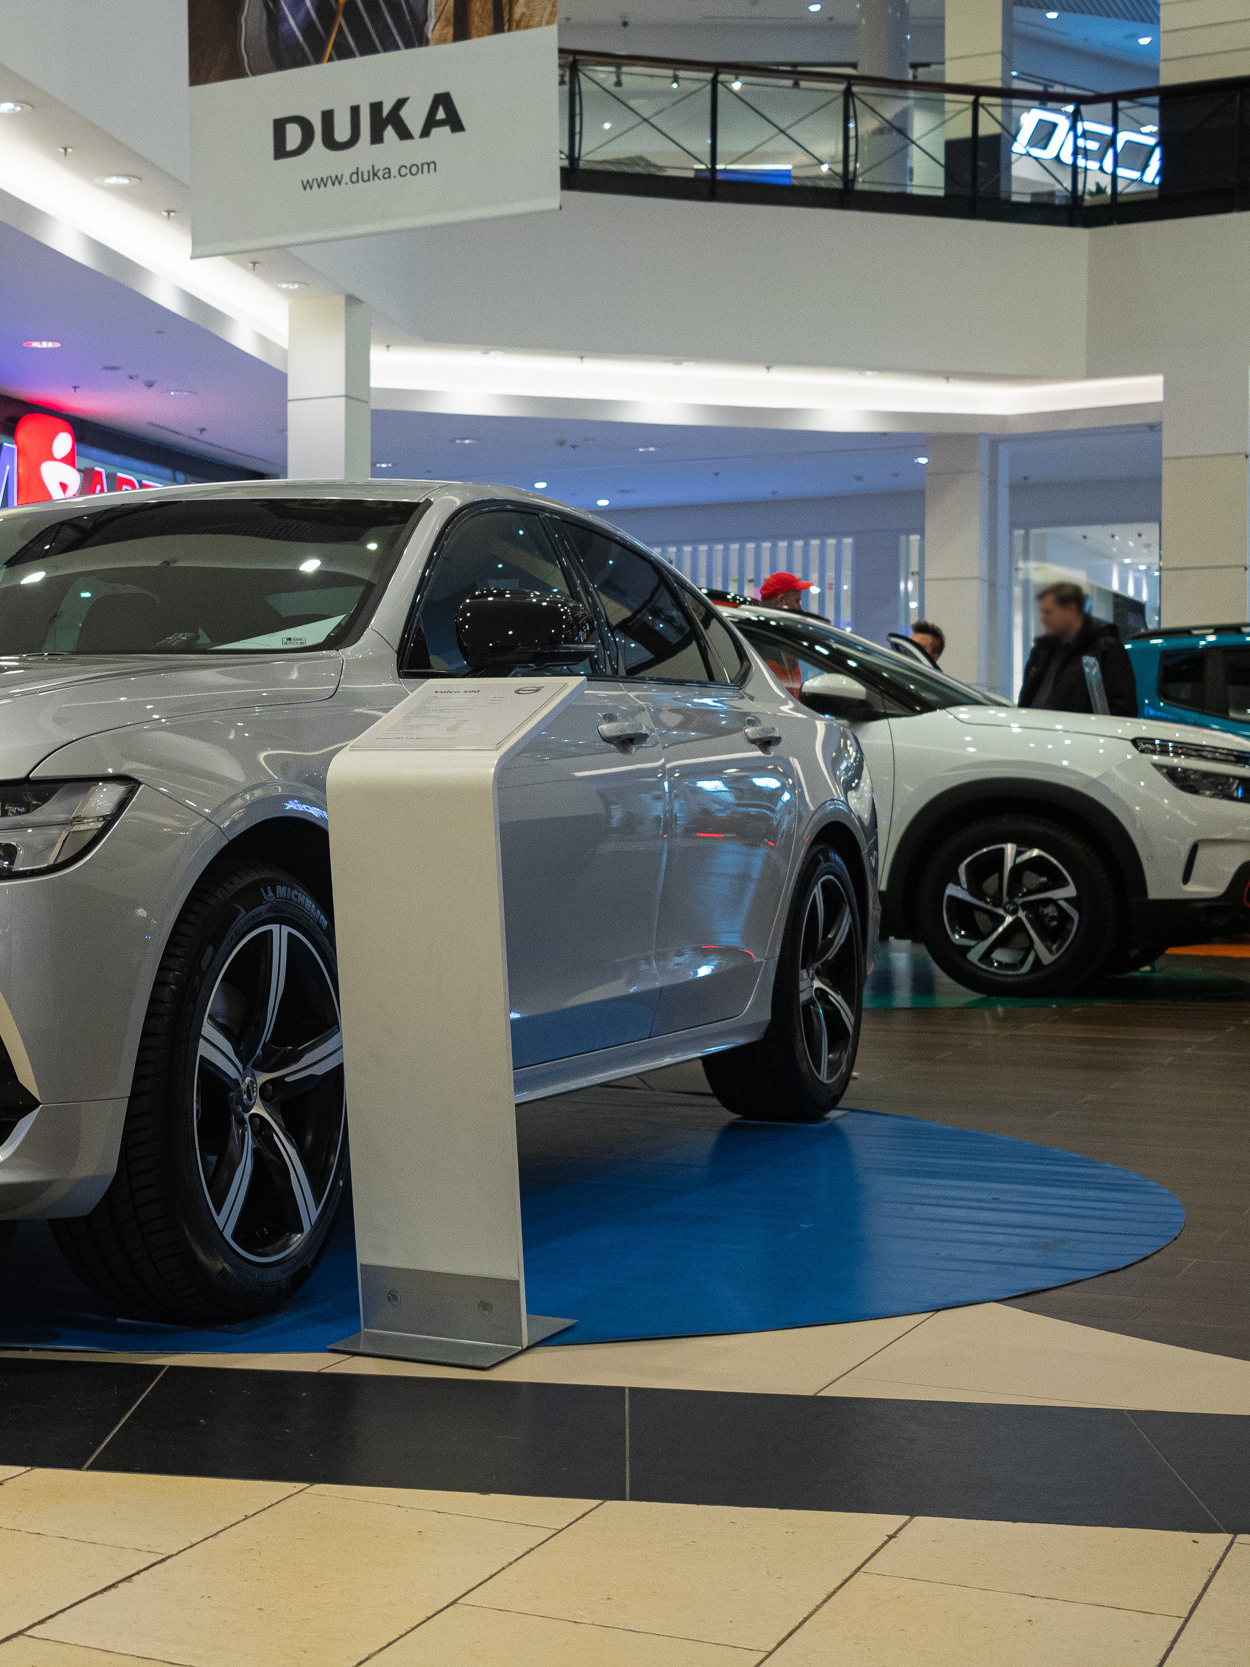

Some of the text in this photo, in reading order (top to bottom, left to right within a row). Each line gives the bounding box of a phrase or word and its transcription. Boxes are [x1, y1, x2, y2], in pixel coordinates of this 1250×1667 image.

[273, 91, 466, 161] DUKA
[301, 159, 437, 192] www.duka.com
[276, 885, 328, 930] MICHELIN
